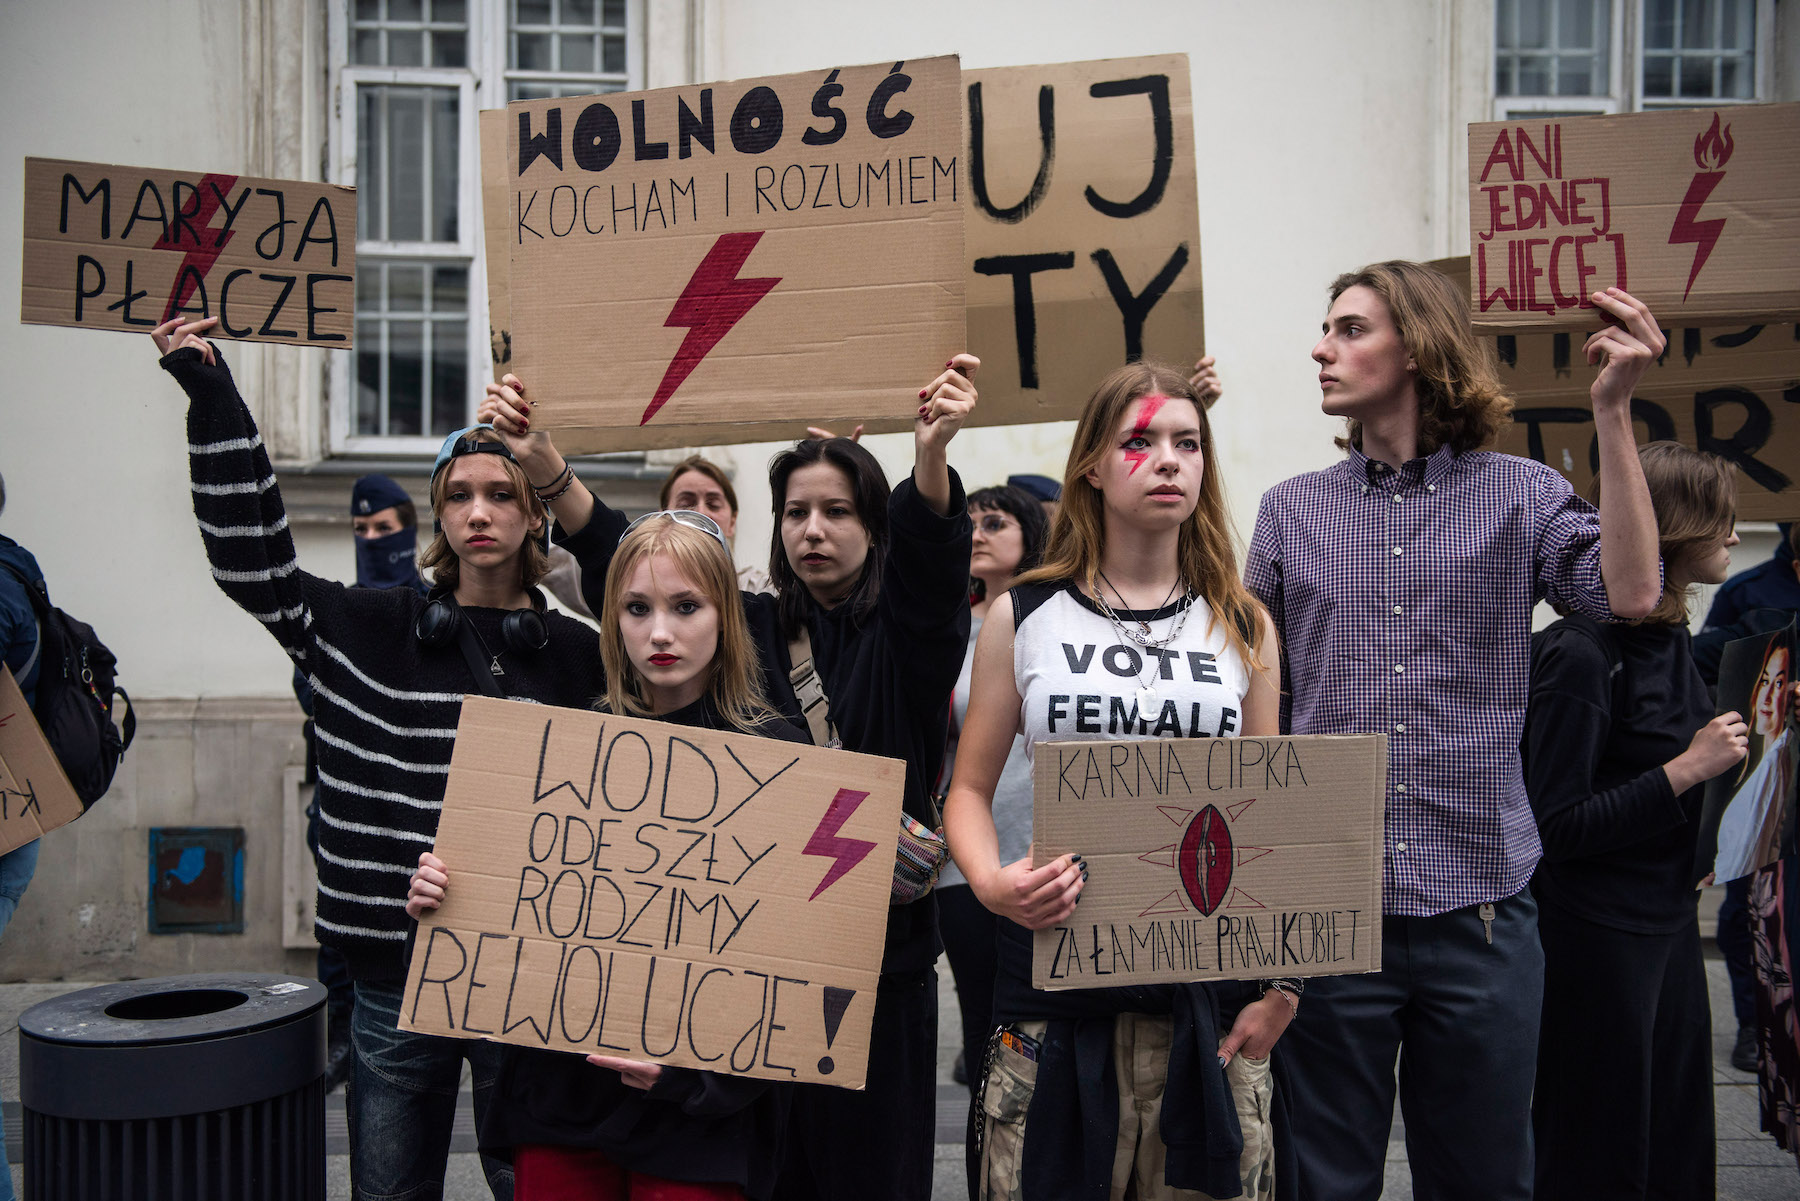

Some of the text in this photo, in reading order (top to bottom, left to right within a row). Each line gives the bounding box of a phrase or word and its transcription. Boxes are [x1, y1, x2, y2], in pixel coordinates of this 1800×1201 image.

[518, 61, 914, 177] WOLNOŚĆ
[1480, 124, 1562, 182] ANI
[59, 173, 338, 267] MARYJA
[518, 156, 957, 244] KOCHAM I ROZUMIEM
[1478, 177, 1610, 240] JEDNEJ
[75, 255, 353, 340] PŁACZE
[1478, 233, 1627, 323] WIĘCEJ
[1061, 642, 1222, 685] VOTE
[533, 719, 800, 827] WODY
[1058, 740, 1308, 801] KARNA CIPKA
[529, 812, 777, 885] ODESZŁY
[511, 866, 759, 954] RODZIMY
[1050, 927, 1082, 979] ZA
[1089, 919, 1208, 975] ŁAMANIE
